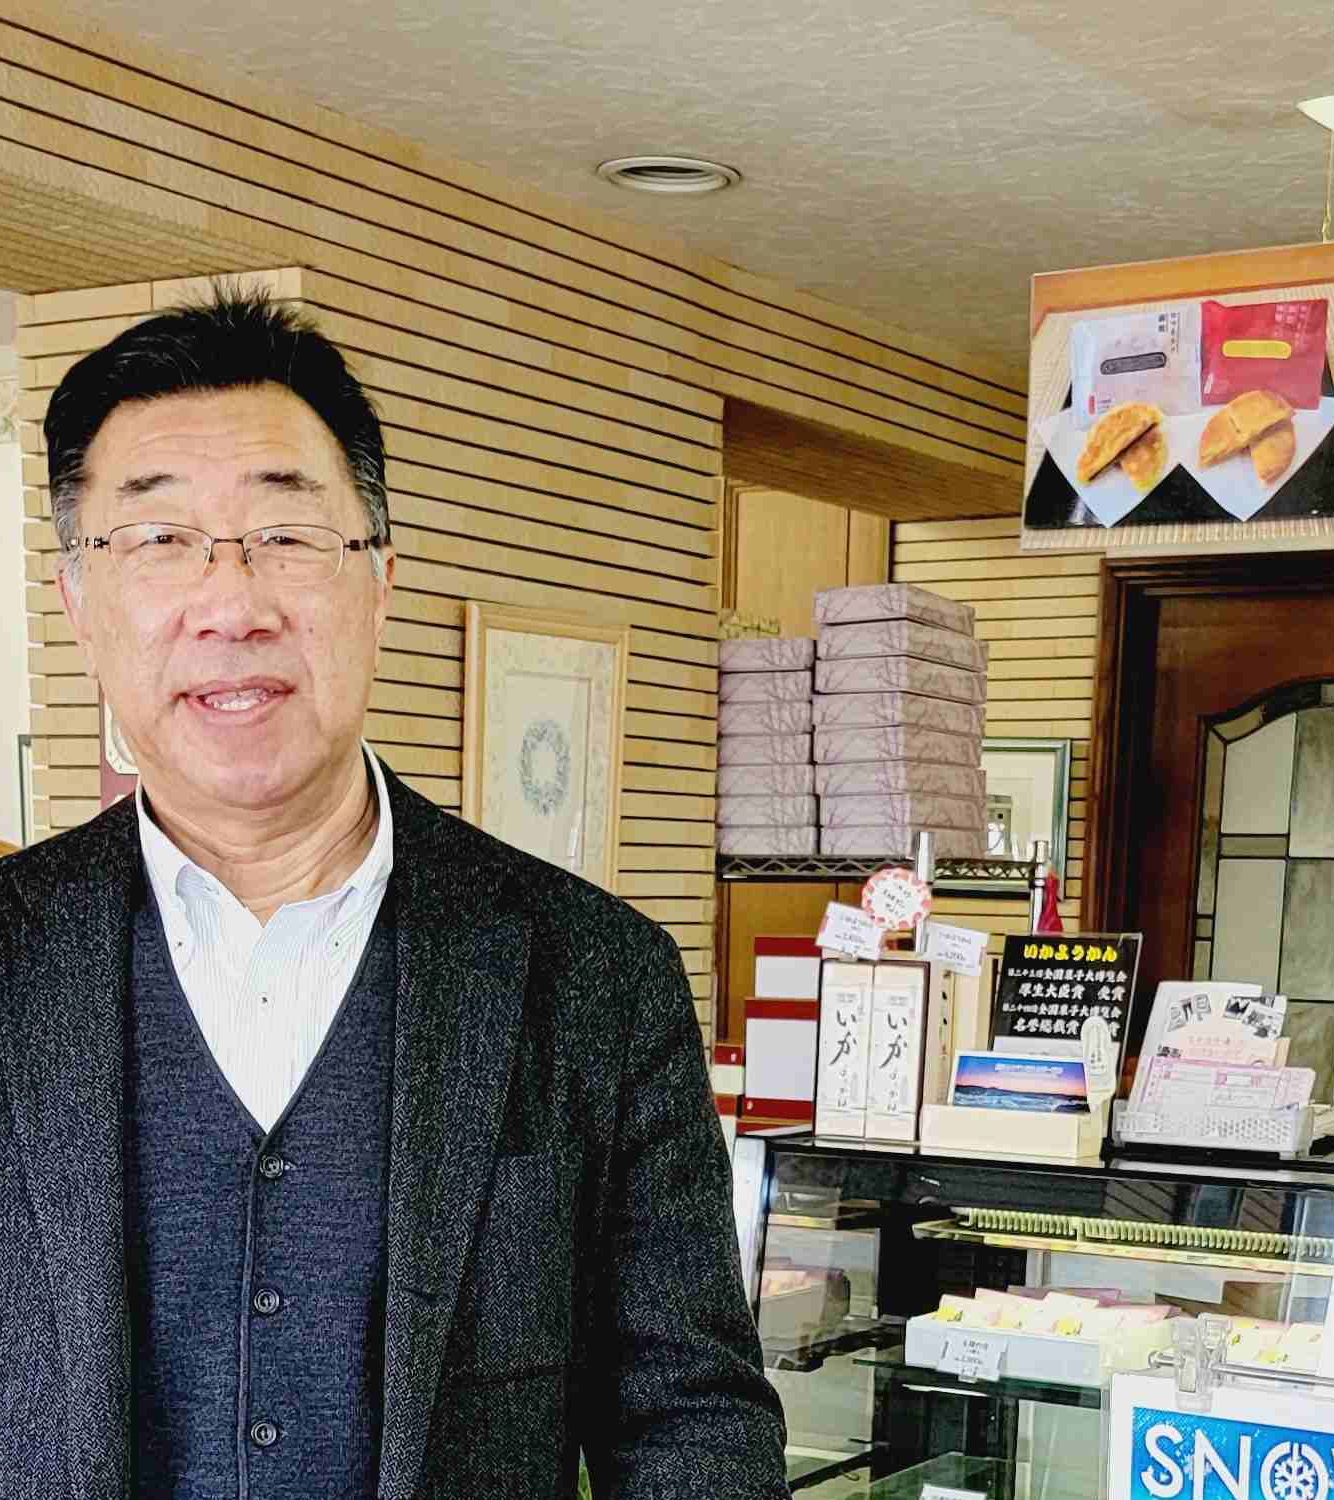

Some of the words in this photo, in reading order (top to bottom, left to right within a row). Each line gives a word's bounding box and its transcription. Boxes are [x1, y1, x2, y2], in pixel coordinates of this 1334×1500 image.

[1023, 943, 1118, 962] いかようかん
